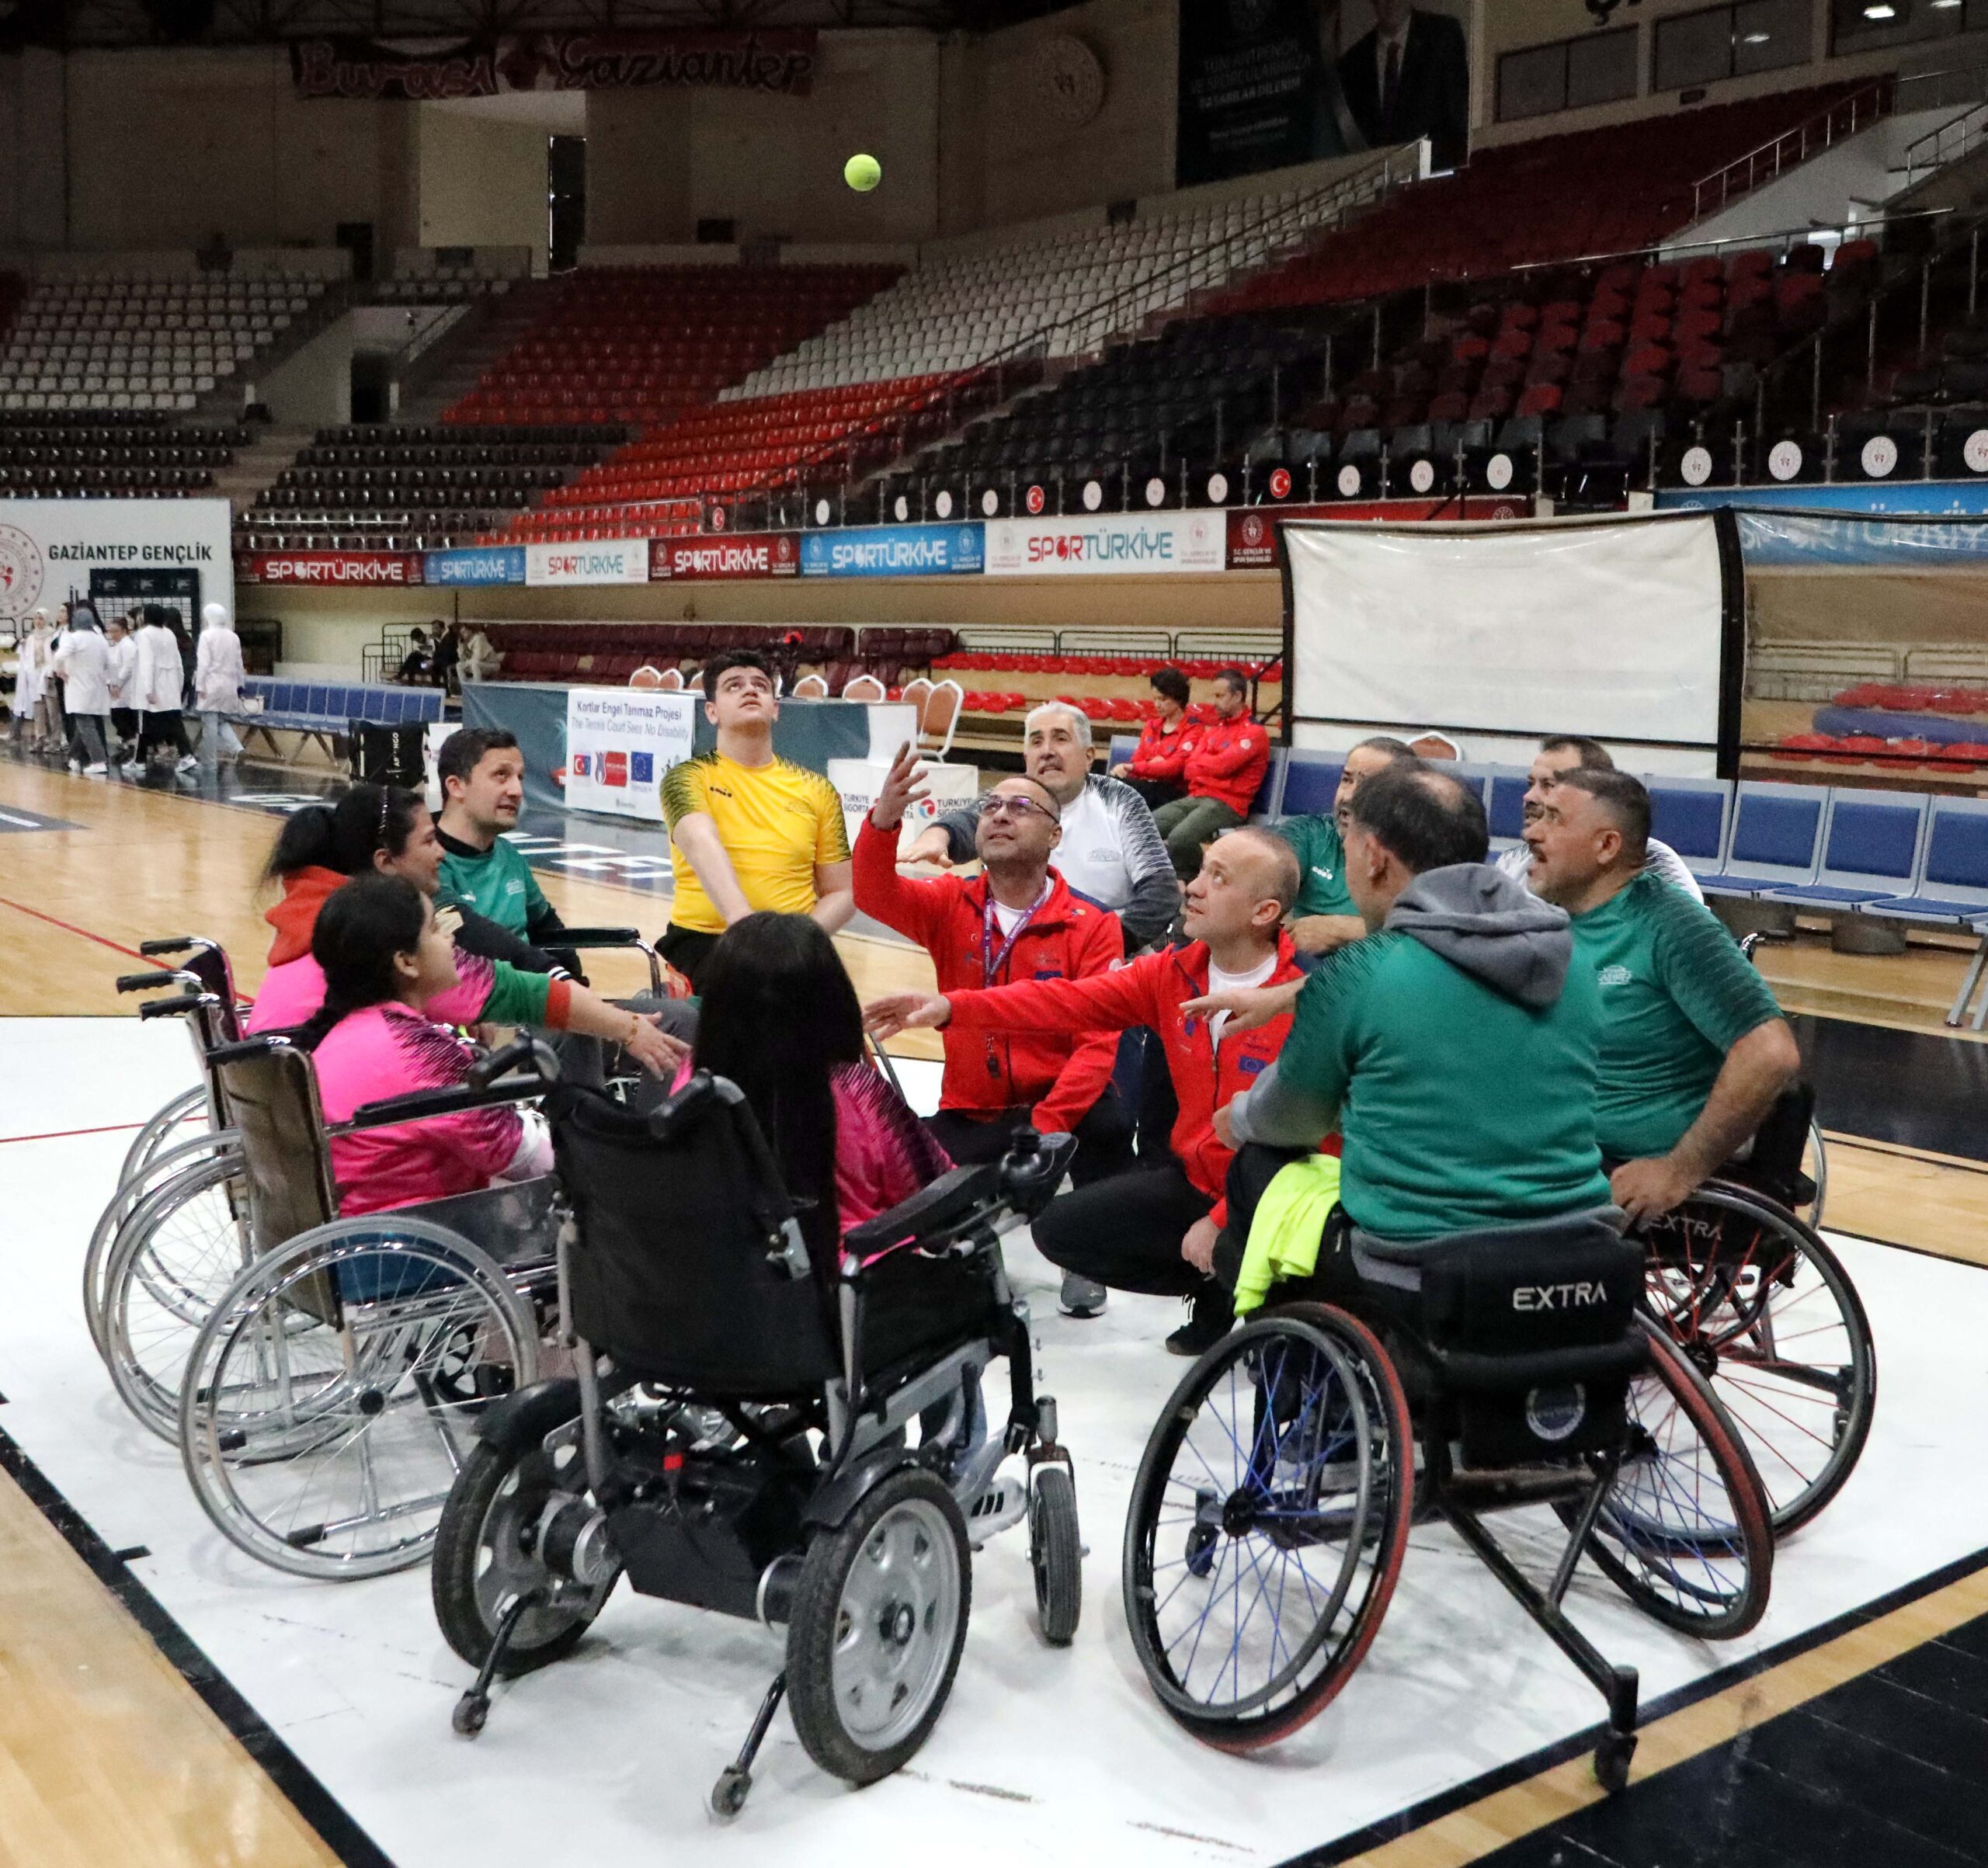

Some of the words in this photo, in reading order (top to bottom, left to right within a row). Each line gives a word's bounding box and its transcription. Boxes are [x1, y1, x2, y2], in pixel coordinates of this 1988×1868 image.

[49, 542, 137, 560] GAZİANTEP
[142, 542, 212, 564] GENÇLİK
[832, 537, 947, 568] SPORTÜRKİYE
[1027, 526, 1173, 562] SPORTÜRKİYE
[266, 558, 403, 581] SPORTÜRKİYE
[548, 551, 623, 575] SPORTÜRKİYE
[675, 543, 768, 572] SPORTÜRKİYE
[577, 700, 600, 713] Kortlar
[603, 702, 623, 717] Engel
[655, 707, 682, 721] Projesi
[572, 717, 583, 729] The
[645, 724, 655, 735] No
[1514, 1282, 1607, 1311] EXTRA
